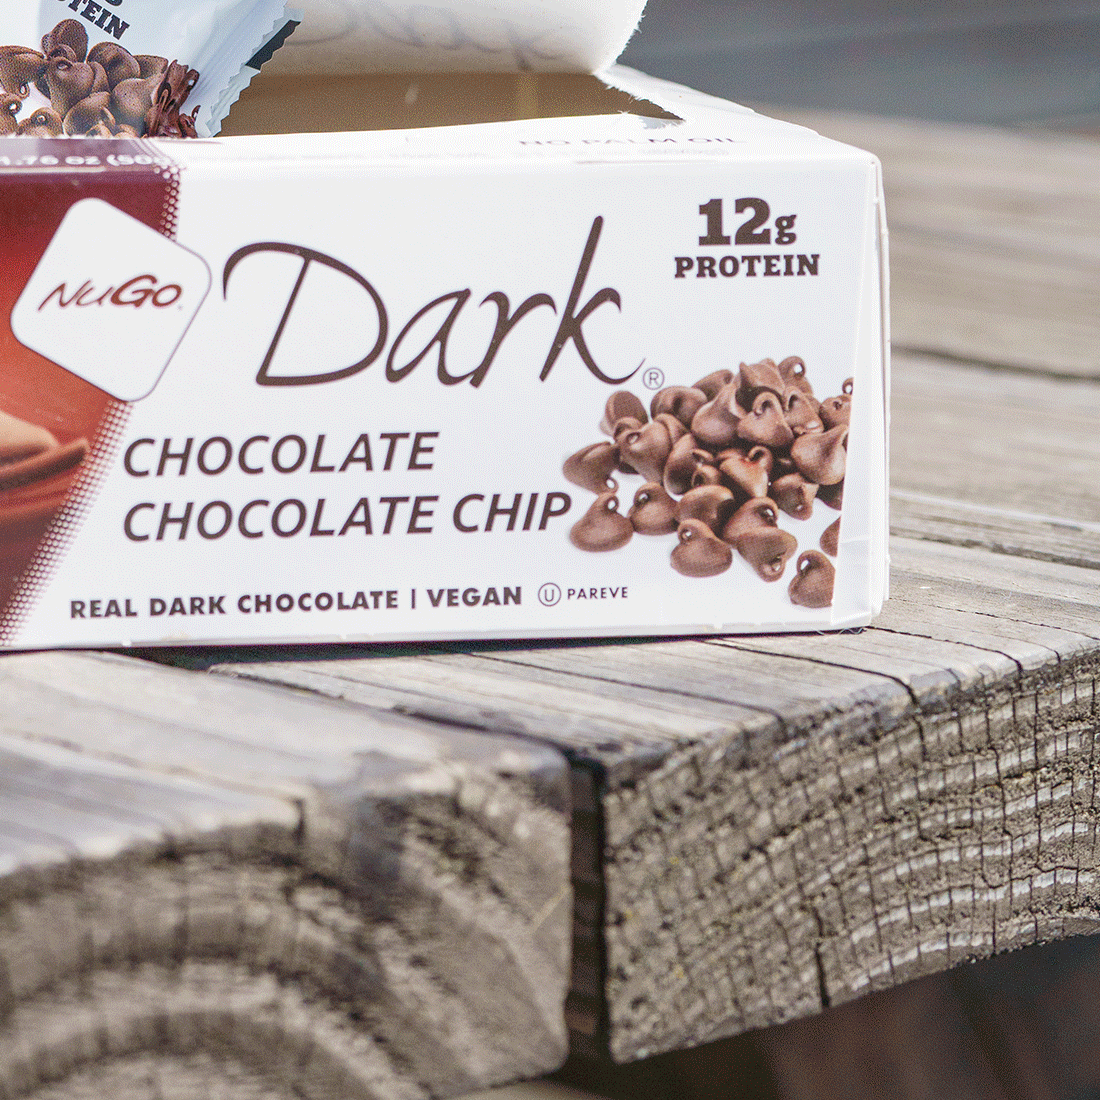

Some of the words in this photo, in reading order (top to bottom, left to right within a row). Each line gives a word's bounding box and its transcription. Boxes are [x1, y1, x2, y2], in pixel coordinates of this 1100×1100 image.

[698, 197, 797, 246] 12g
[674, 253, 820, 279] PROTEIN
[38, 274, 183, 311] NuGo
[223, 215, 646, 388] Dark
[123, 431, 440, 478] CHOCOLATE
[122, 495, 440, 542] CHOCOLATE
[452, 491, 573, 533] CHIP
[70, 599, 138, 620] REAL
[149, 595, 227, 617] DARK
[237, 590, 399, 614] CHOCOLATE
[426, 586, 522, 609] VEGAN
[567, 587, 629, 601] PAREVE
